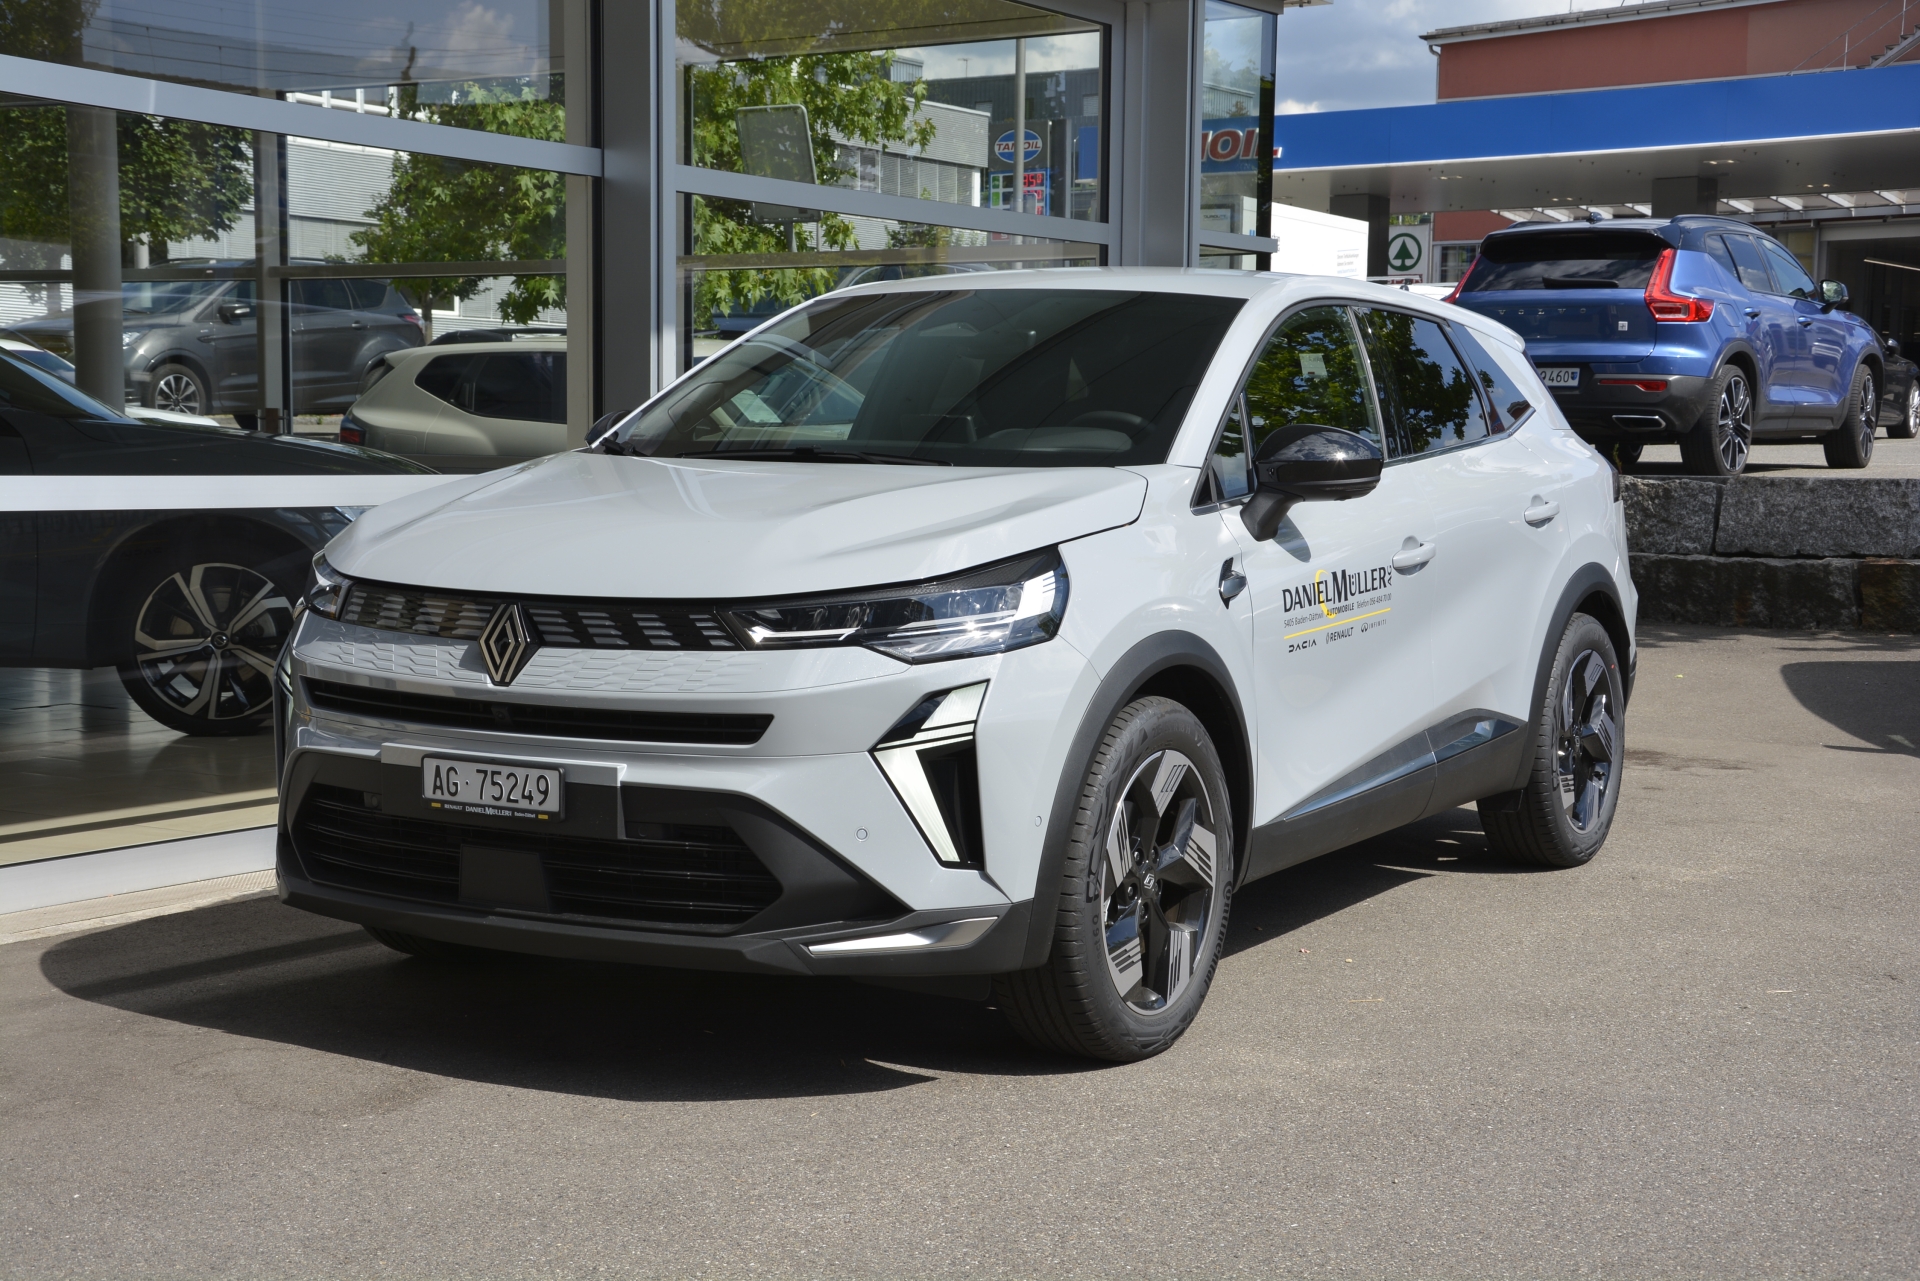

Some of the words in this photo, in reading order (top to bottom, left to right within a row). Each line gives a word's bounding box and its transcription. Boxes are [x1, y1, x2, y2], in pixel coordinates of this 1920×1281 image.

[1326, 603, 1355, 617] AUTOMOBILE
[1356, 599, 1369, 609] Telefon
[1369, 619, 1387, 629] INFINITI
[1329, 627, 1354, 642] RENAULT
[1288, 639, 1317, 653] DACIA
[432, 764, 460, 797] AG
[476, 768, 551, 806] 75249
[1204, 881, 1233, 988] Continental
